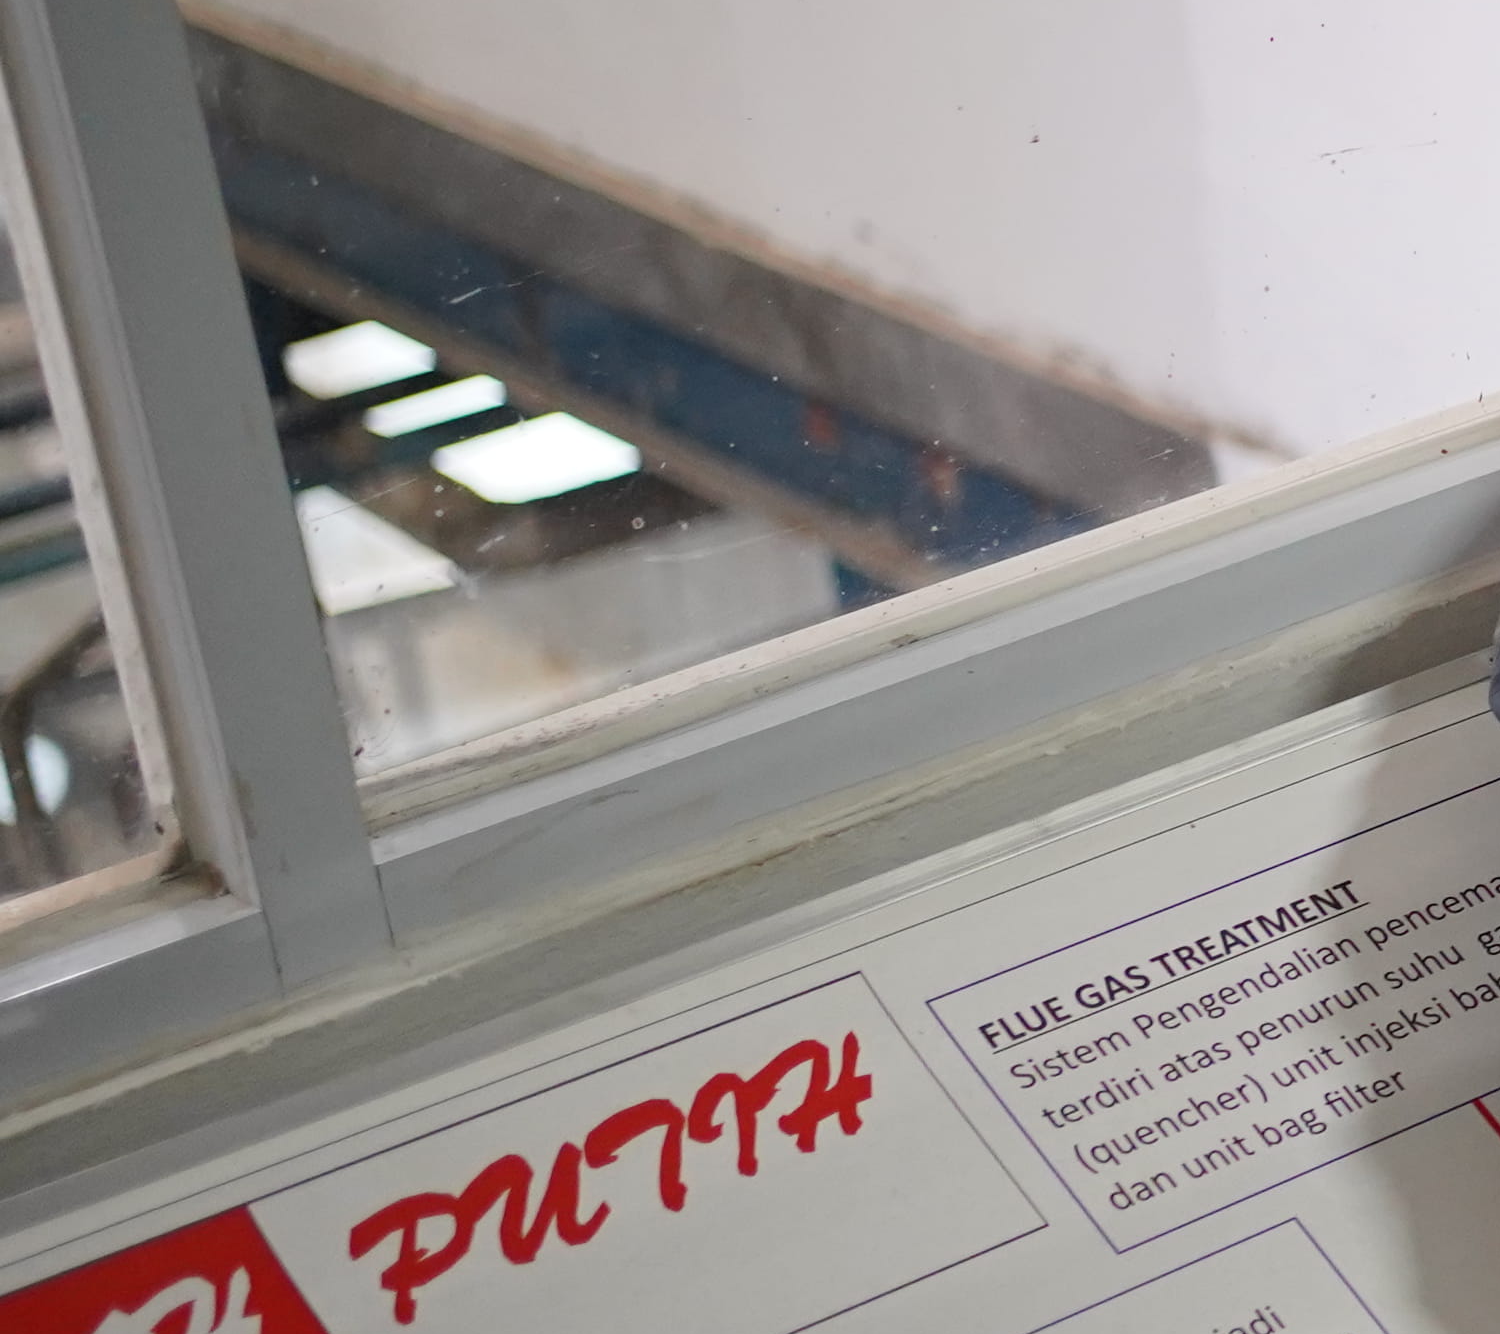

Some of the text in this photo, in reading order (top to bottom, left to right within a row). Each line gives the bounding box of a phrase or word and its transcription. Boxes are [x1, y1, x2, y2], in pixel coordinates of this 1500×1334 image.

[978, 880, 1360, 1049] FLUE GAS TREATMENT
[1009, 1029, 1131, 1089] Sistem
[1132, 938, 1361, 1039] Pengendalian
[1041, 1068, 1155, 1129] terdiri
[1158, 1041, 1231, 1082] atas
[1236, 980, 1380, 1055] penurun
[1383, 944, 1465, 990] suhu
[1073, 1074, 1268, 1174] (quencher)
[1271, 1035, 1343, 1087] unit
[1344, 996, 1451, 1057] injeksi
[1108, 1070, 1406, 1211] dan unit bag filter
[348, 1030, 872, 1326] PUTIH
